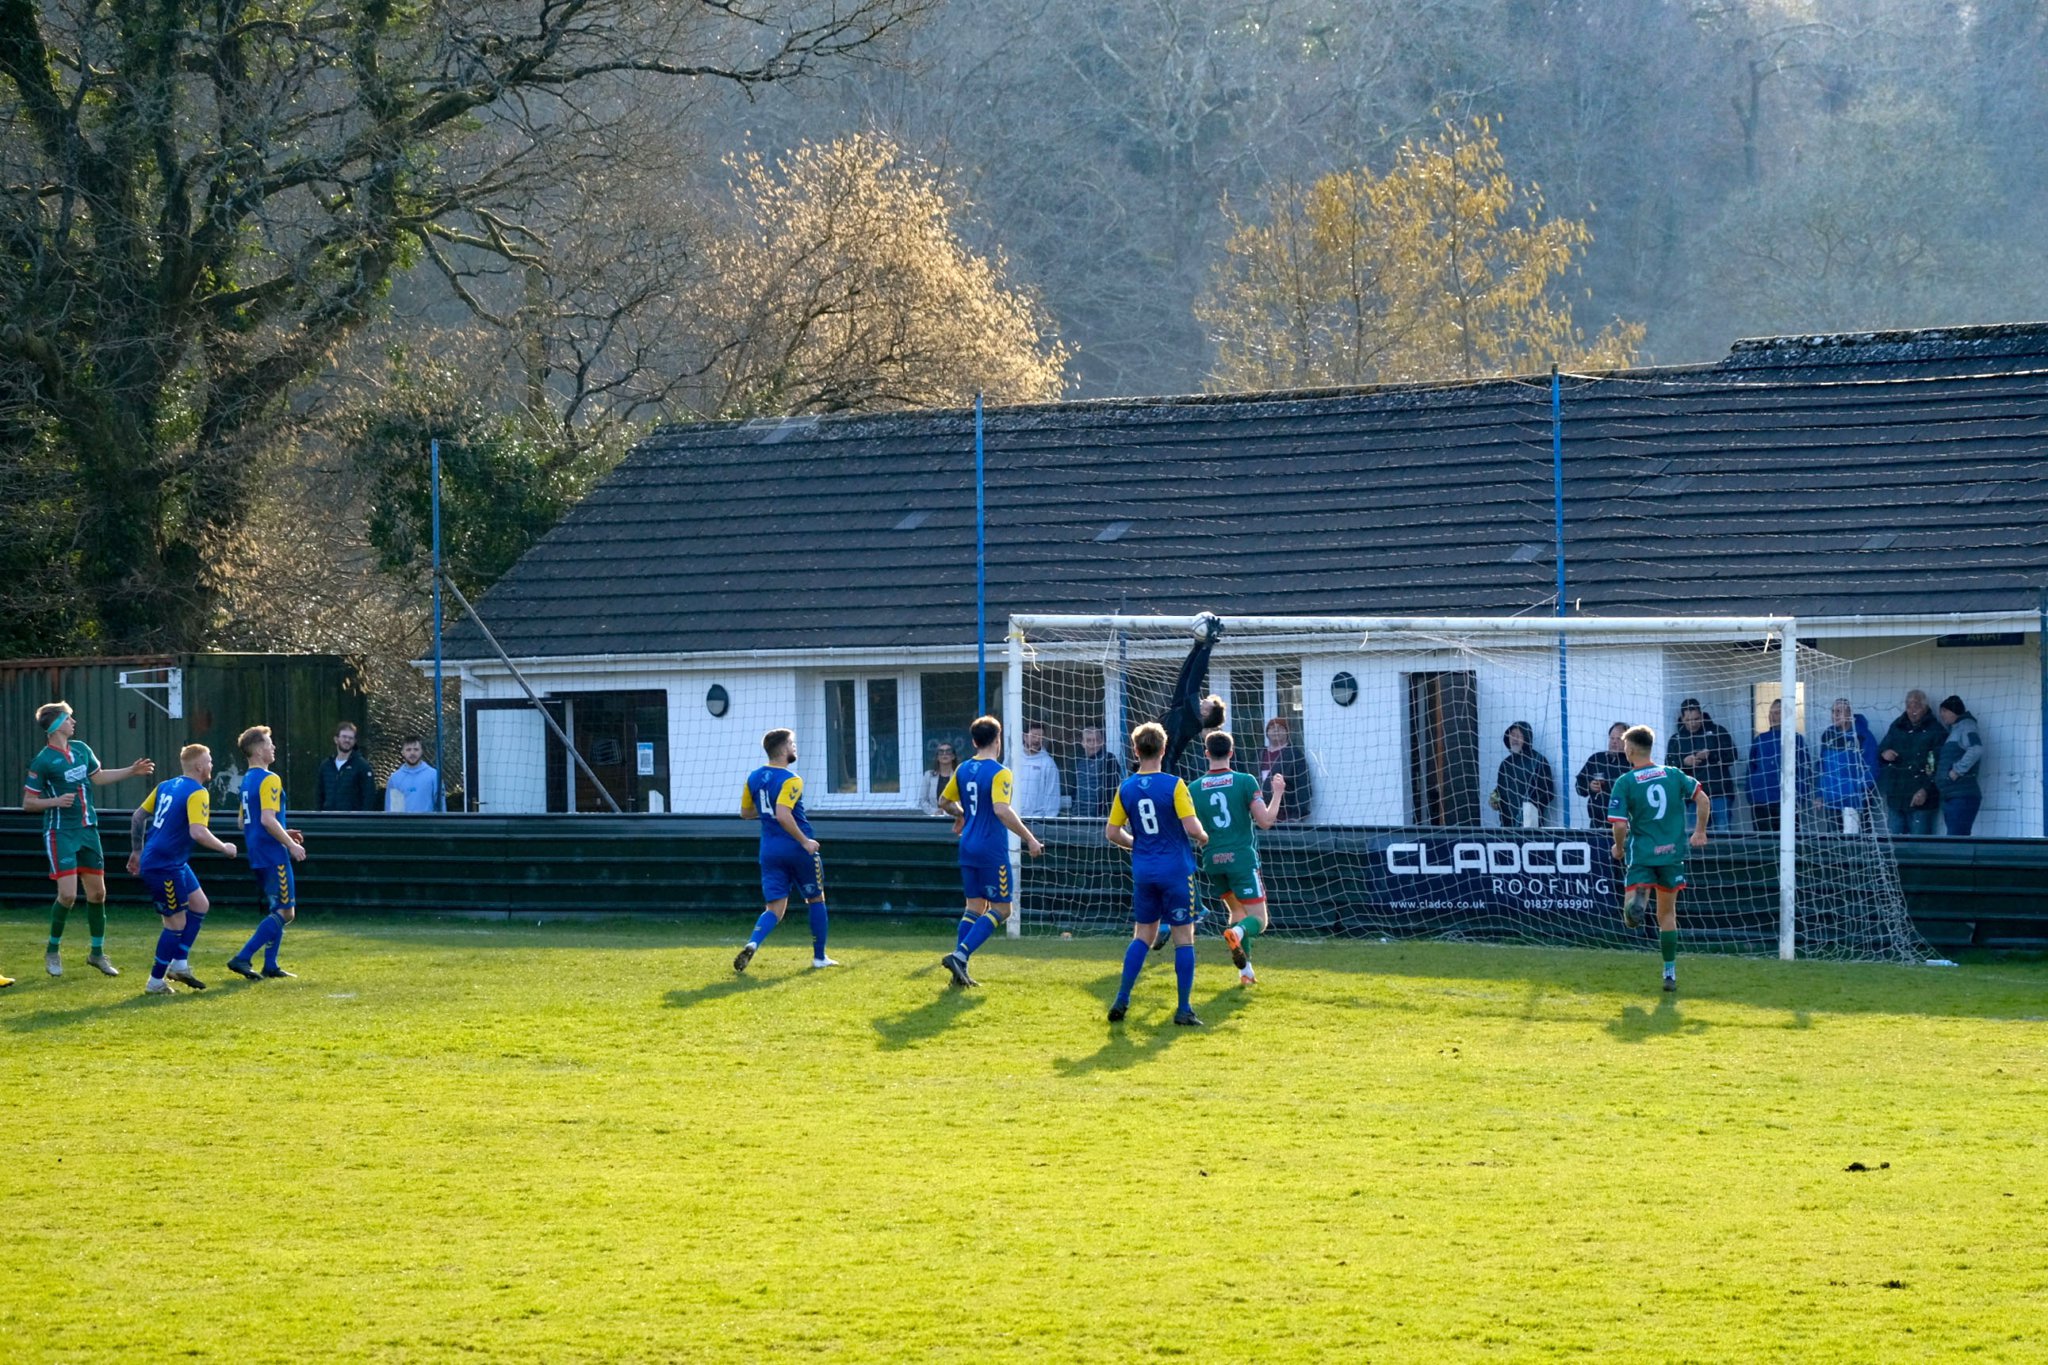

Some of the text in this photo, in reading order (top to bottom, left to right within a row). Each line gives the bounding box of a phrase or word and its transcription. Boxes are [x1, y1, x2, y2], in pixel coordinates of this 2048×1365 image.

[155, 794, 173, 828] 12
[759, 788, 777, 819] 4
[967, 782, 978, 816] 3
[1210, 793, 1231, 828] 3
[1647, 784, 1667, 819] 9
[1138, 799, 1158, 834] 8
[1387, 842, 1591, 873] CLADCO
[1390, 898, 1485, 909] www.cladco.co.uk
[1492, 878, 1609, 895] ROOFING
